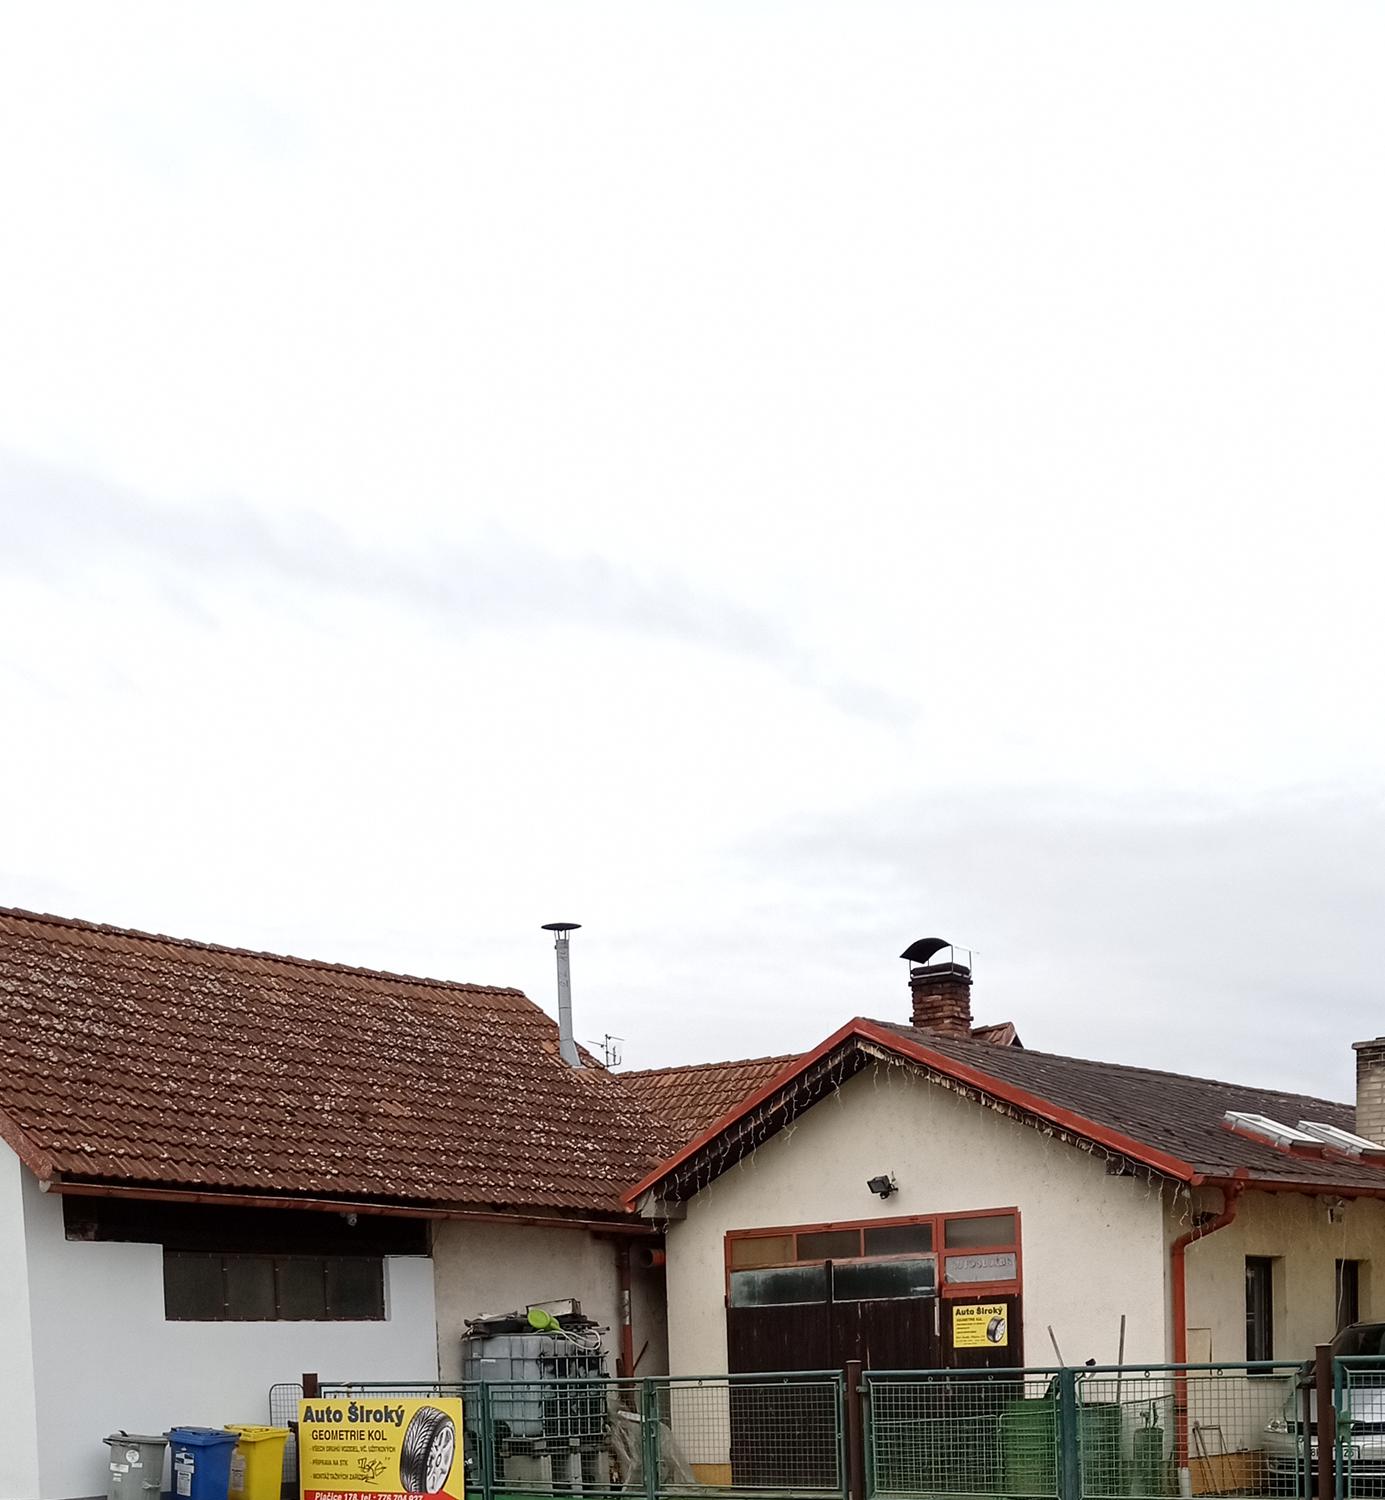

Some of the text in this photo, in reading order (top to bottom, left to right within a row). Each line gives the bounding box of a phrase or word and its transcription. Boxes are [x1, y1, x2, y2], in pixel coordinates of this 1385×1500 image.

[955, 1308, 975, 1316] Auto
[303, 1405, 343, 1423] Auto
[311, 1429, 388, 1441] GEOMETRIE KOL
